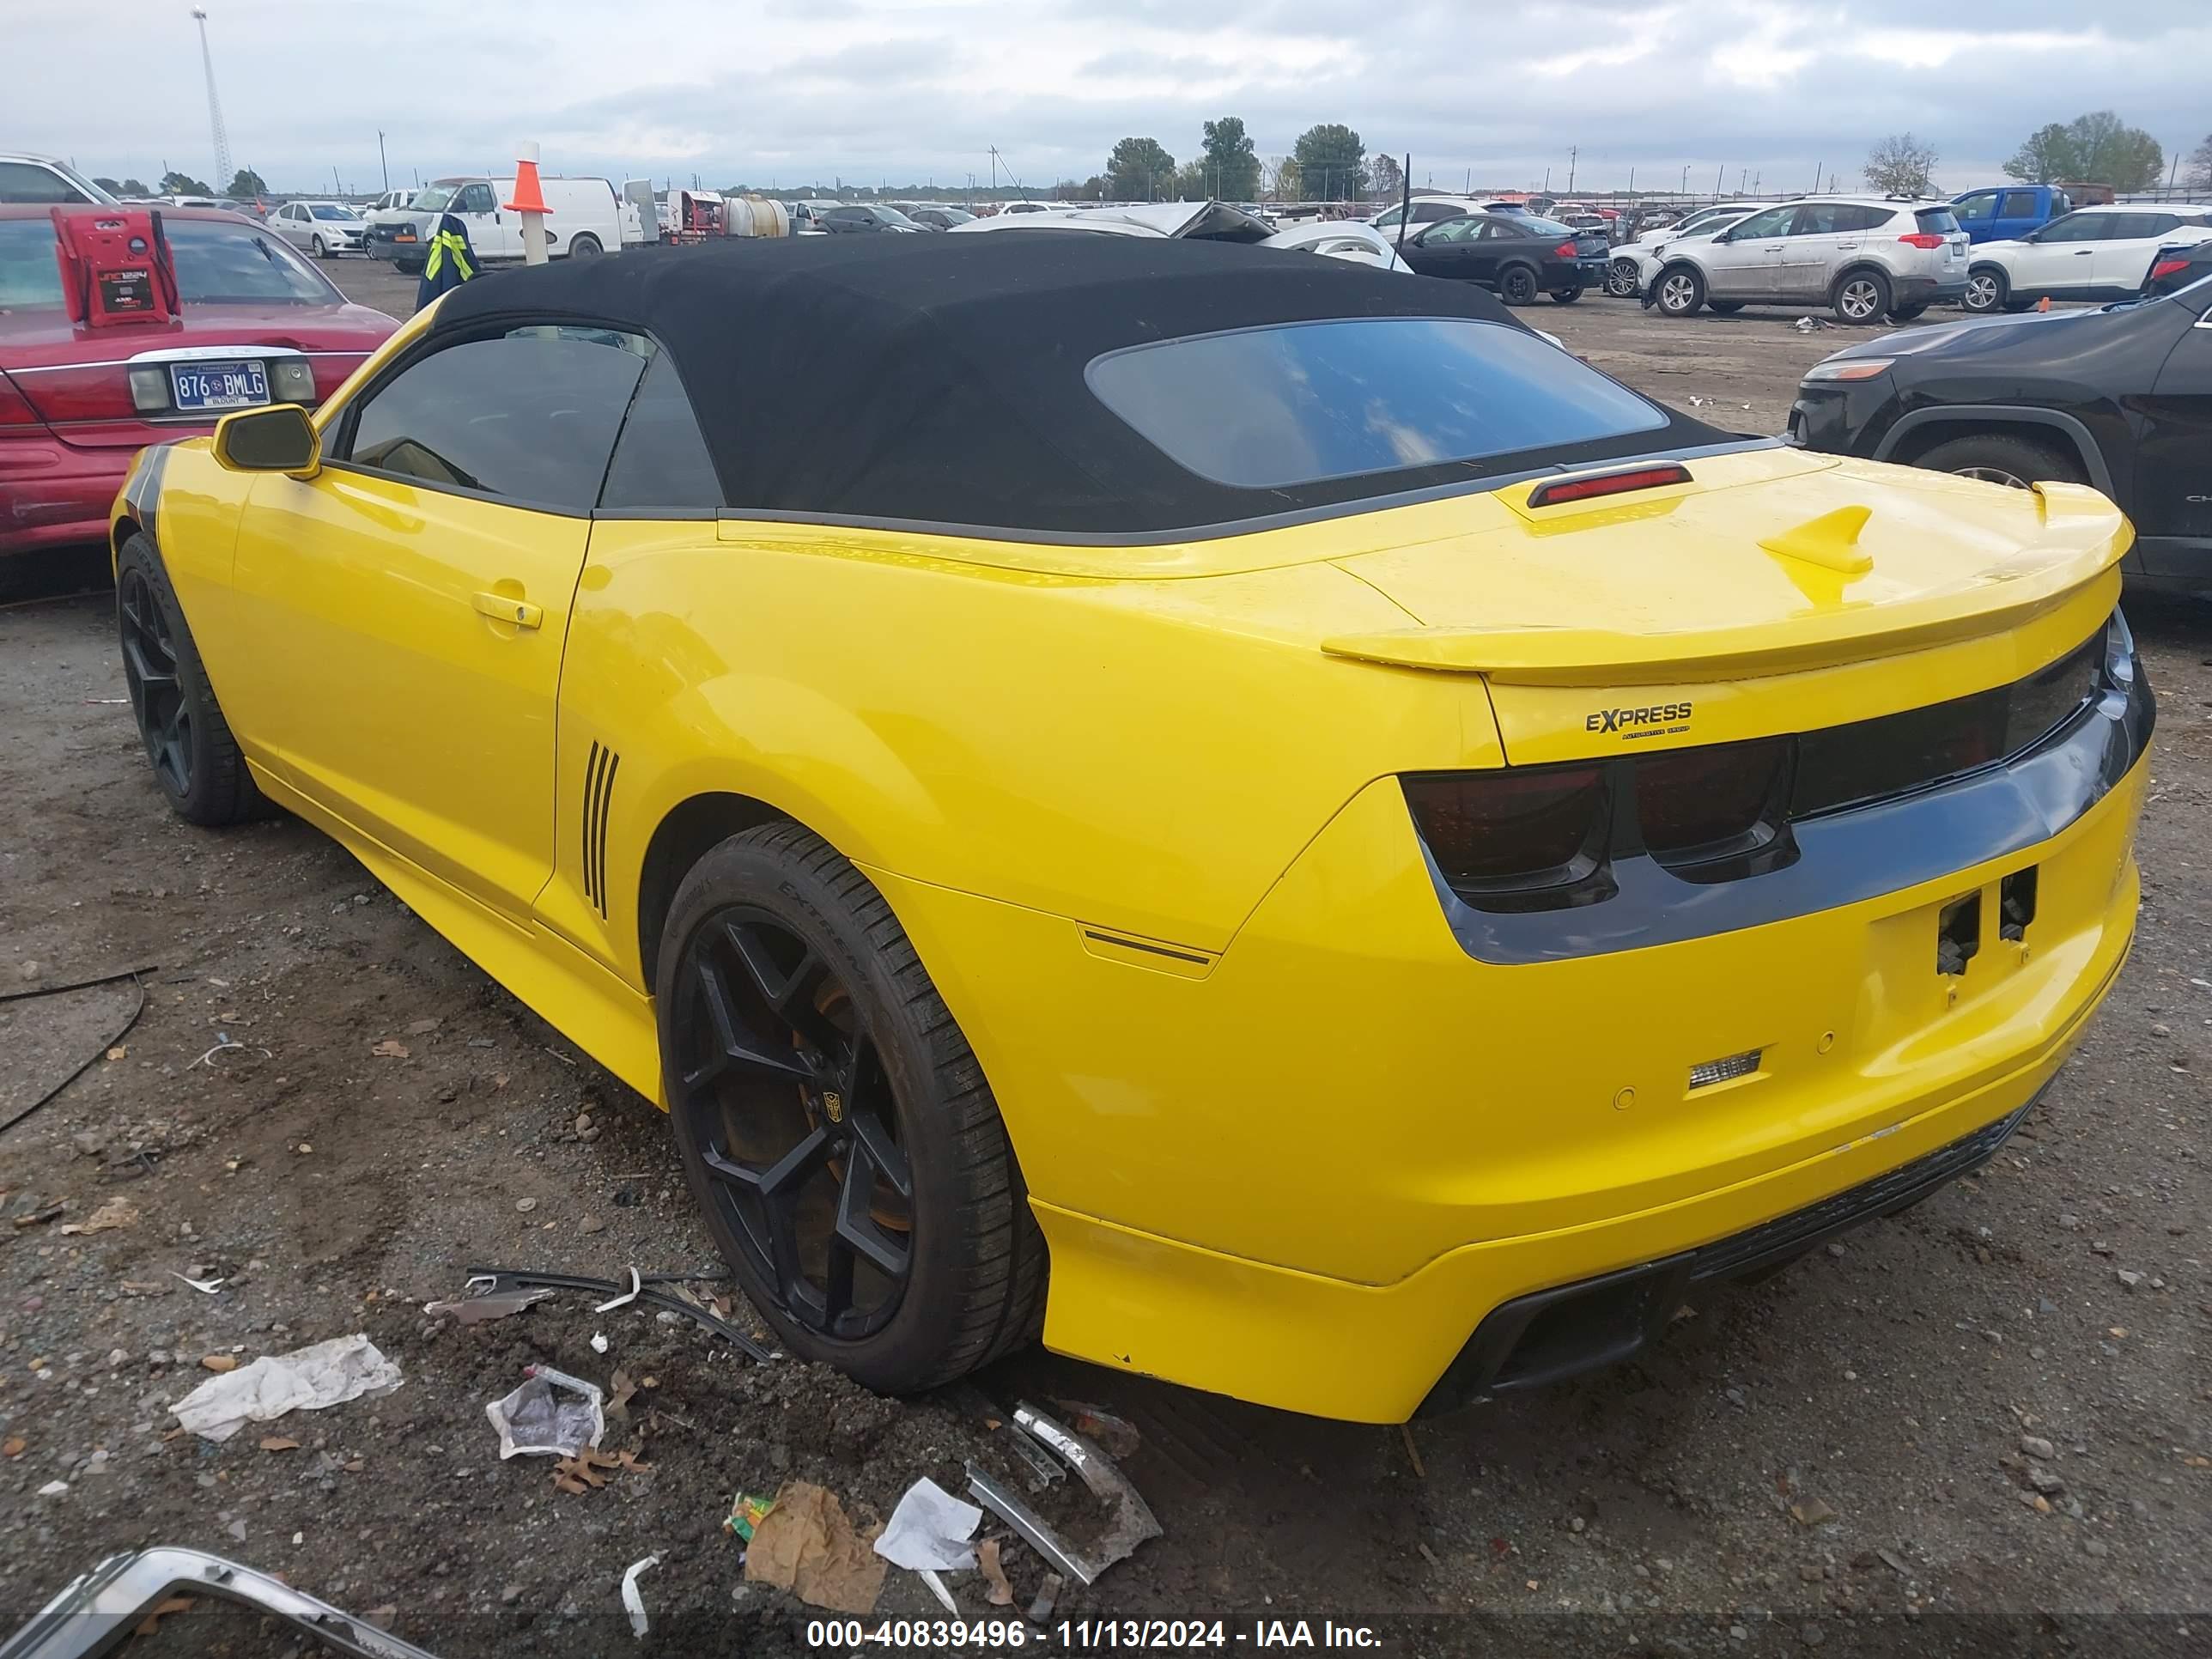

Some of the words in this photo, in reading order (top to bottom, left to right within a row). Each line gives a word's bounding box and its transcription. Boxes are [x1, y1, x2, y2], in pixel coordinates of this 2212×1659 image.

[179, 375, 210, 398] 876
[222, 374, 264, 396] BMLG
[1622, 728, 1665, 740] AUTOMOTIVE
